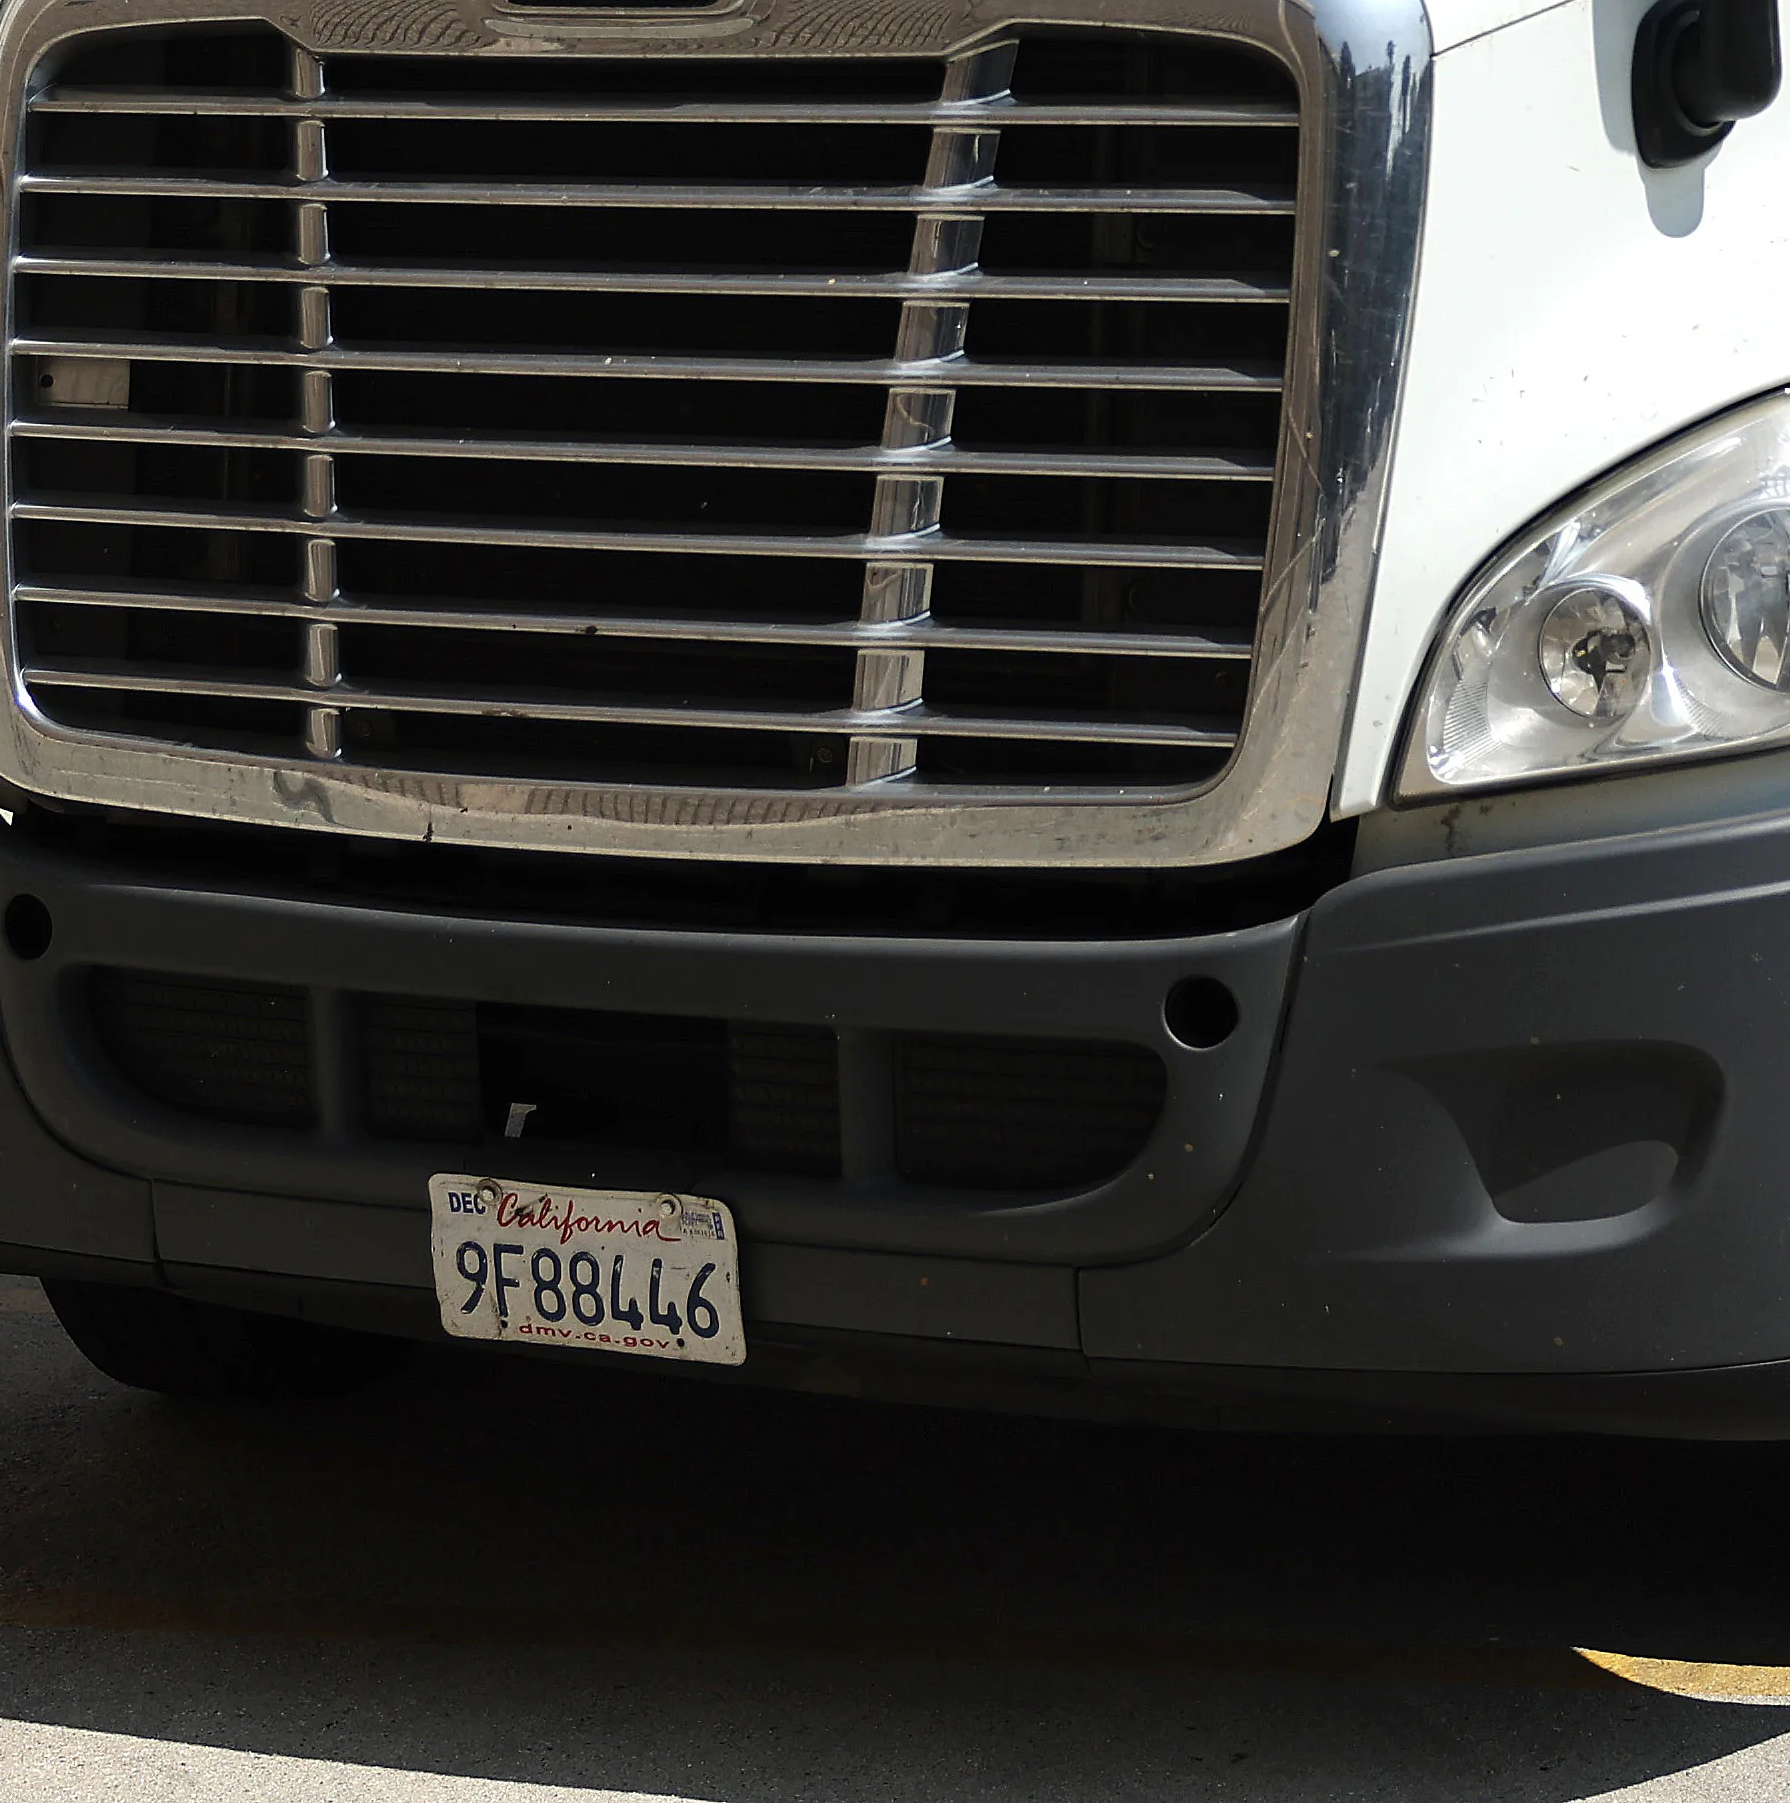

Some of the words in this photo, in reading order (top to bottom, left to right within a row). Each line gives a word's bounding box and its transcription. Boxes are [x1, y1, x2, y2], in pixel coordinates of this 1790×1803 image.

[447, 1192, 487, 1215] DEC
[496, 1193, 681, 1246] California
[456, 1240, 721, 1339] 9F88446
[519, 1323, 669, 1350] dmv.ca.gov
